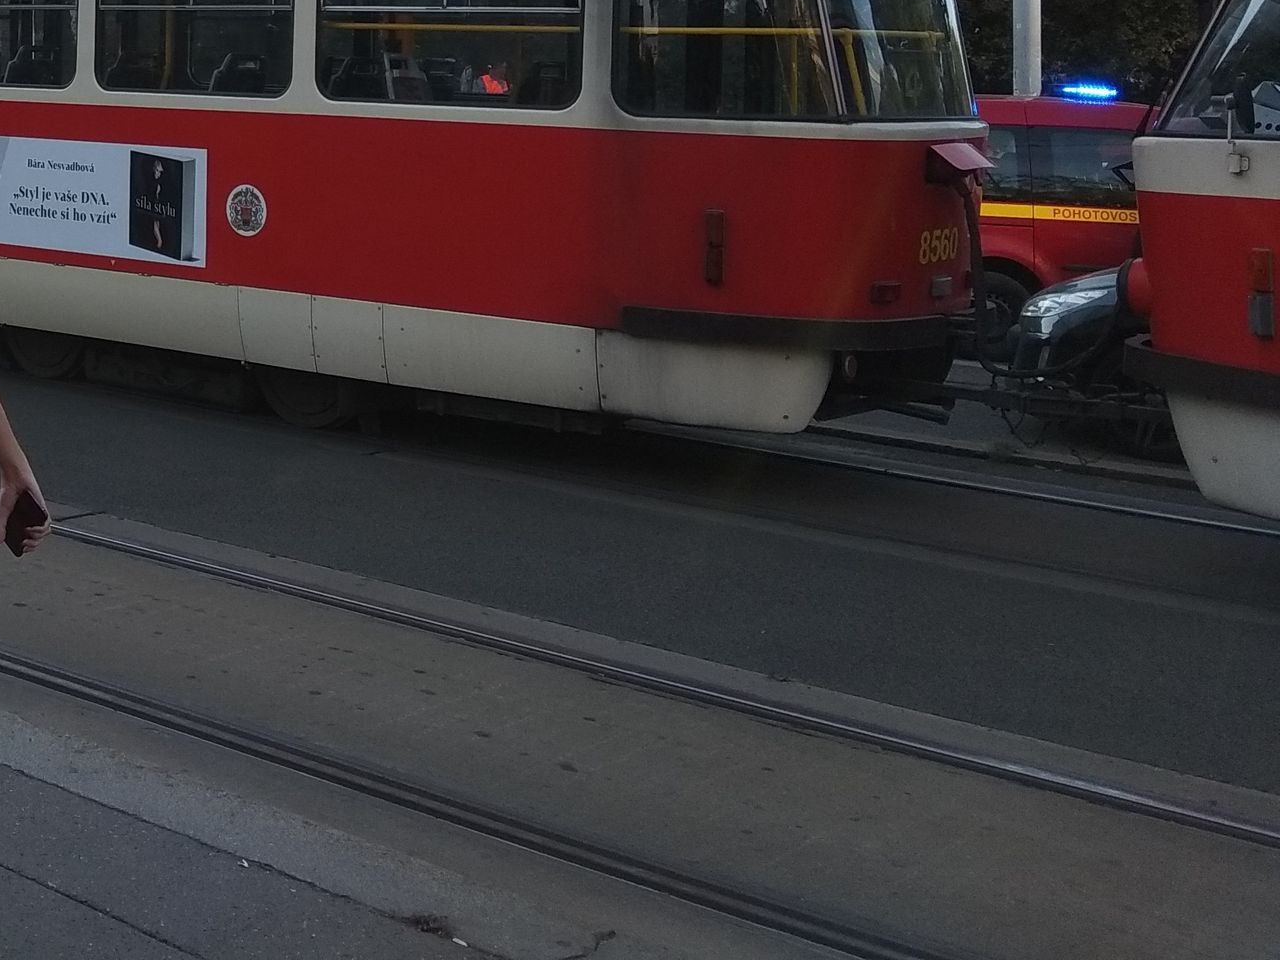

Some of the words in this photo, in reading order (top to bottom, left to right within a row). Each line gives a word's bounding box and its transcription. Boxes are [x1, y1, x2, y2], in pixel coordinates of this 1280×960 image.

[27, 158, 45, 169] Bára
[47, 160, 95, 173] Nesvadbová
[41, 187, 52, 203] je
[54, 190, 78, 203] vaše
[81, 191, 110, 206] DNA.
[9, 202, 58, 219] Nenechte
[60, 207, 70, 220] si
[72, 208, 87, 222] ho
[154, 201, 176, 217] stylu
[1052, 207, 1138, 222] POHOTOVOS
[920, 227, 959, 265] 8560
